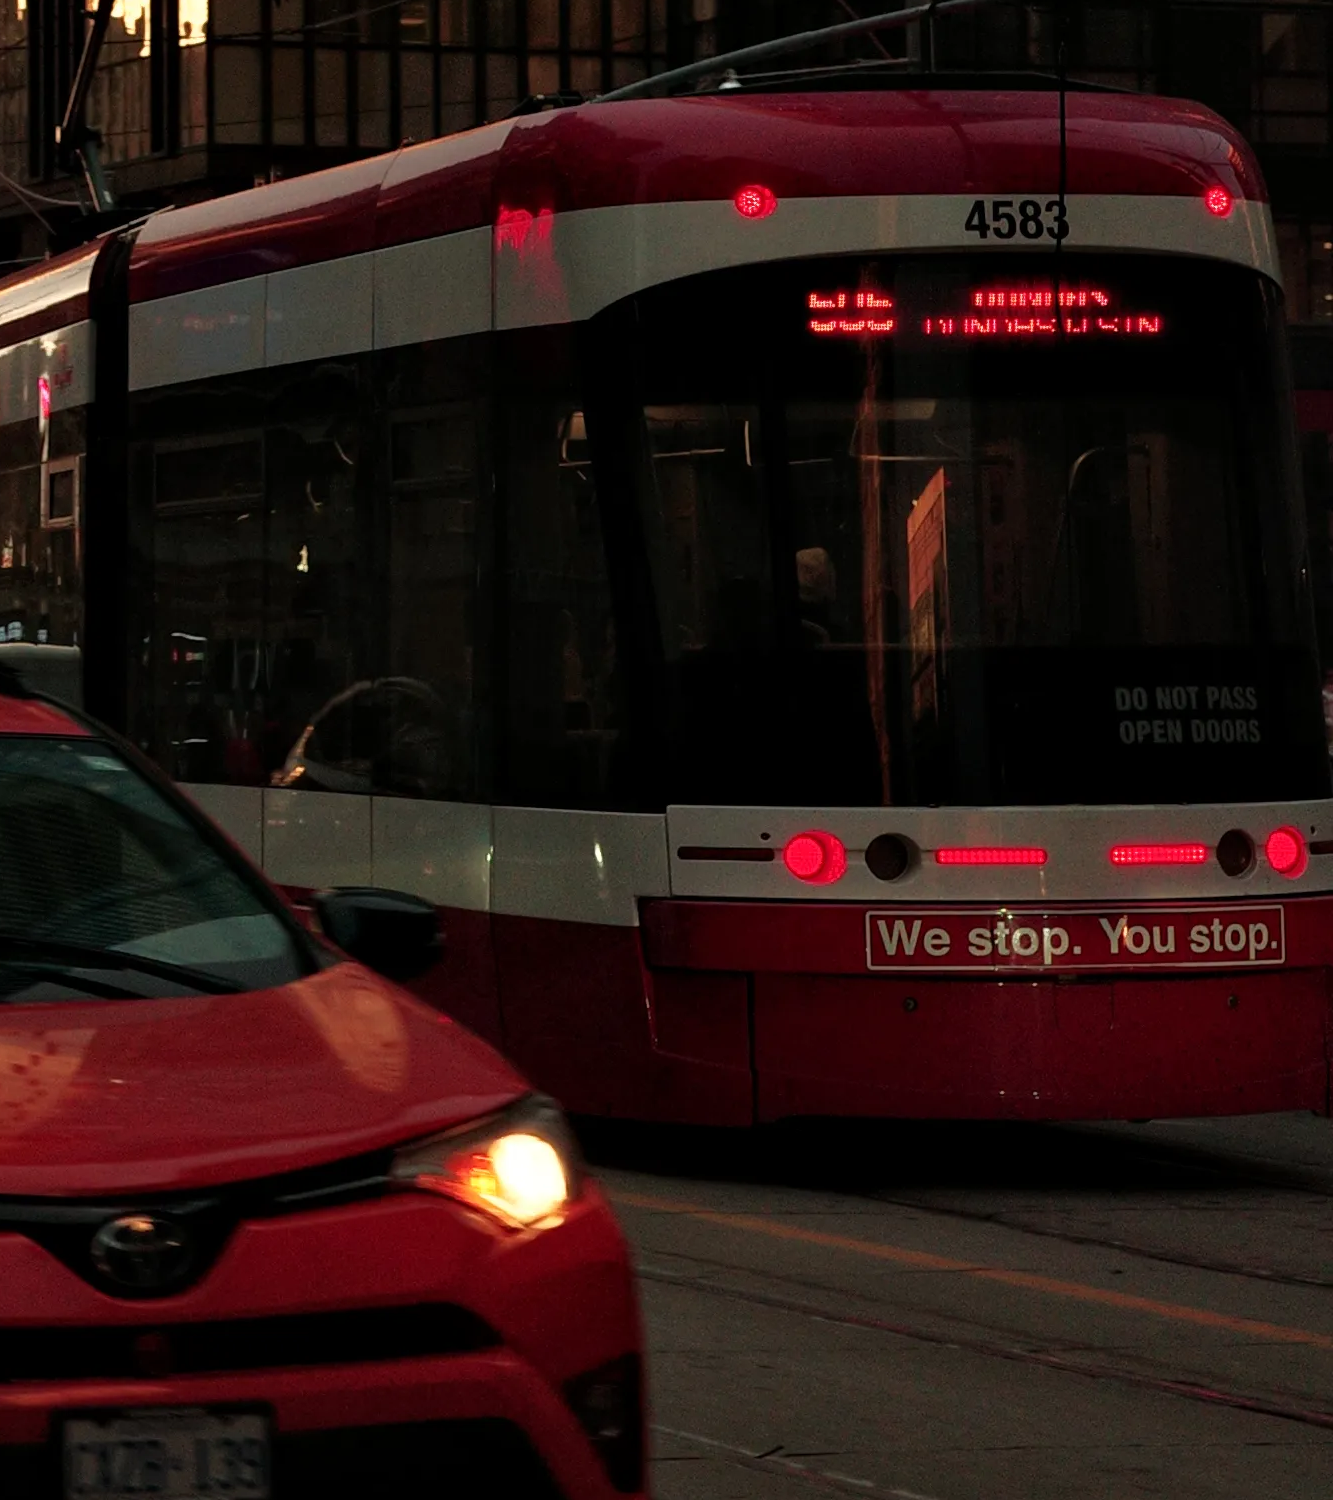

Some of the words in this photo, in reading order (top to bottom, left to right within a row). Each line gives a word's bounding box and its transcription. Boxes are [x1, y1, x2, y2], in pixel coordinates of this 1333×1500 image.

[965, 200, 1070, 239] 4583
[1114, 685, 1148, 712] DO
[1155, 685, 1199, 711] NOT
[1206, 685, 1258, 711] PASS
[1119, 720, 1183, 745] OPEN
[1191, 718, 1262, 744] DOORS
[877, 919, 951, 957] We
[967, 920, 1082, 965] stop.
[1098, 916, 1175, 954] You
[1189, 917, 1278, 961] stop.
